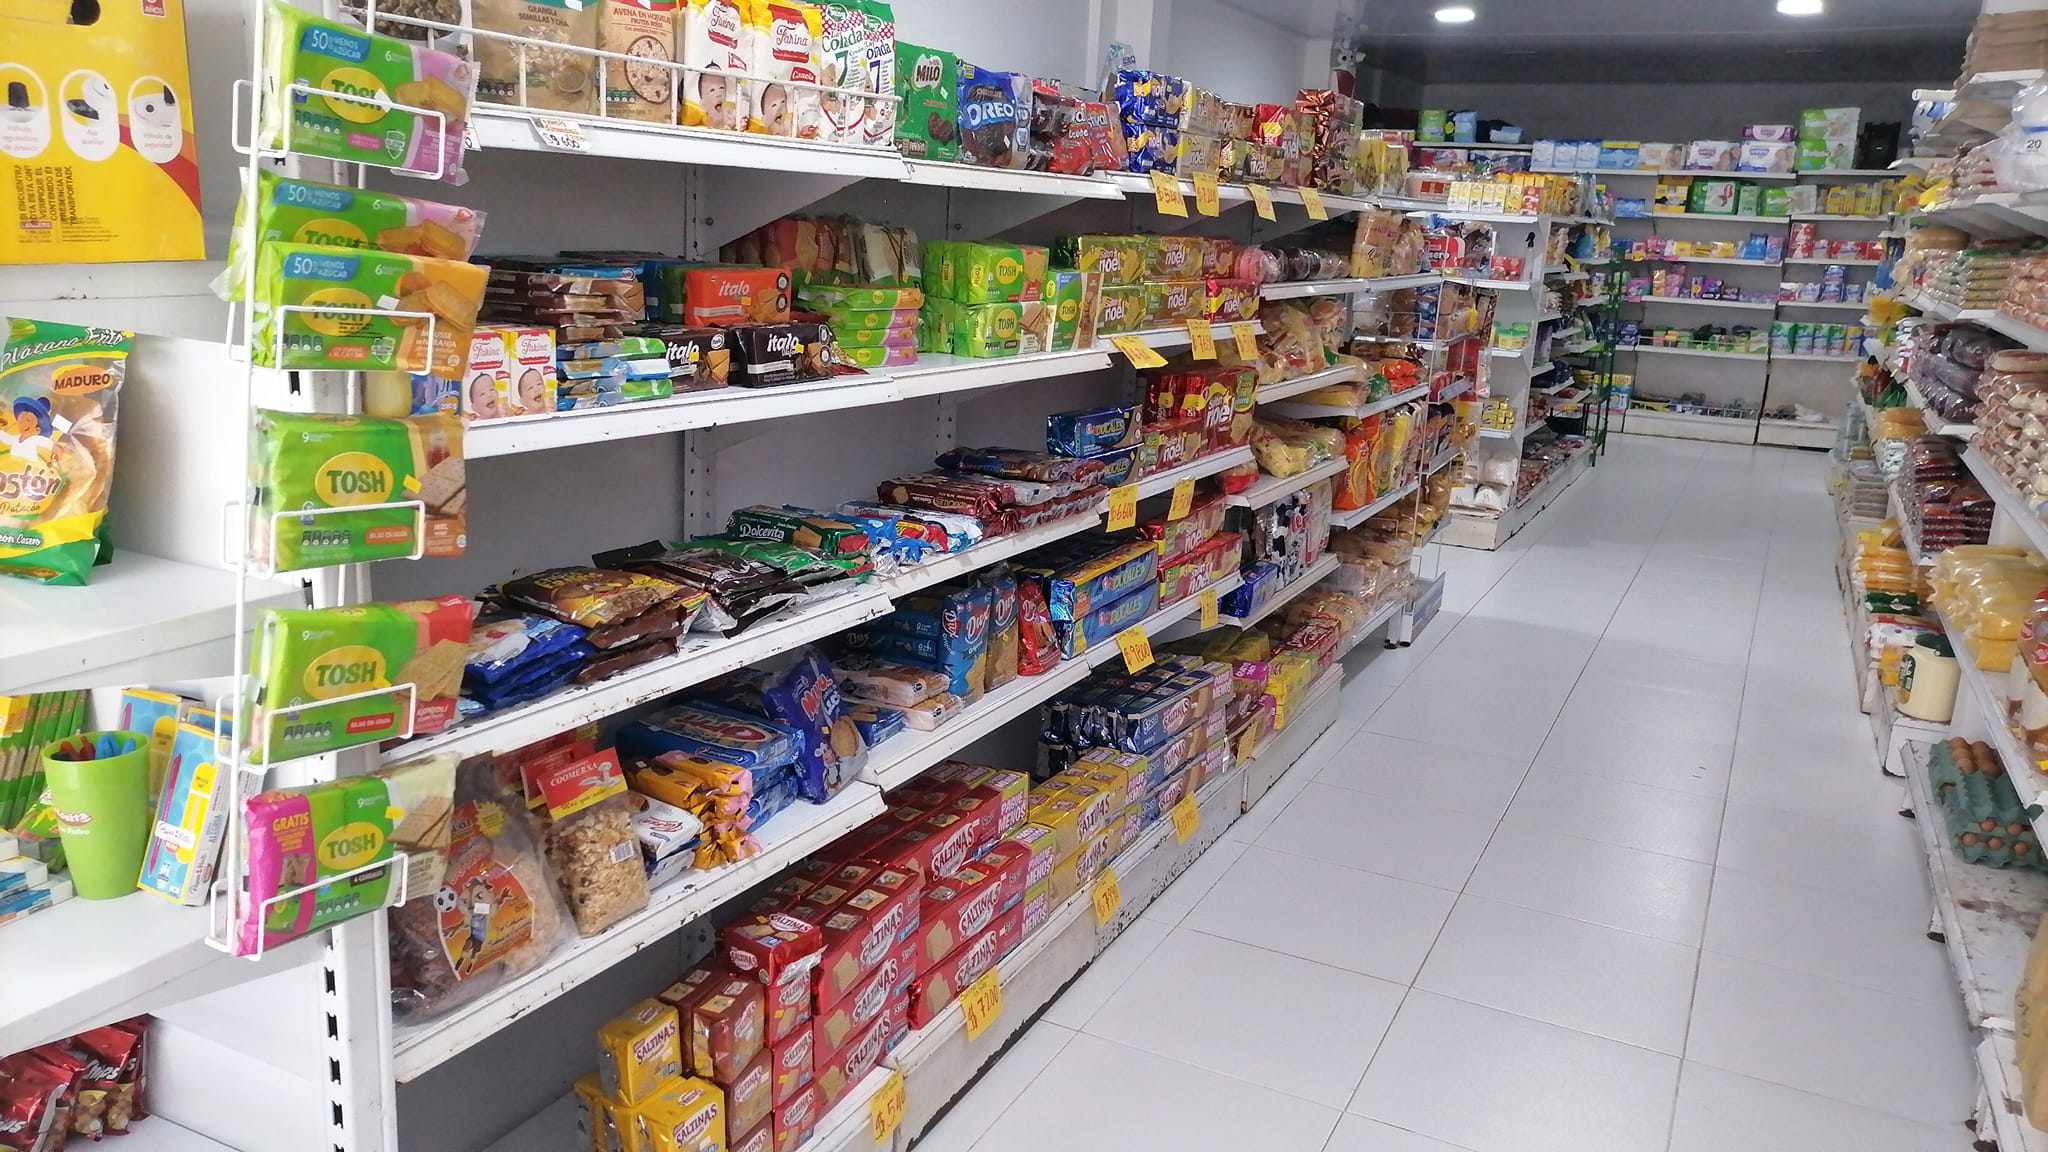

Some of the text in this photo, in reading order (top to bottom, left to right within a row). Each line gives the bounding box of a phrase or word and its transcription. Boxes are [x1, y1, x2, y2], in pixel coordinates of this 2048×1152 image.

[613, 7, 638, 18] AVENA
[310, 29, 329, 50] 50
[384, 50, 393, 62] 6
[835, 50, 849, 87] 7
[869, 60, 881, 95] 7
[916, 64, 941, 82] MILO
[967, 101, 1014, 126] OREO
[2026, 138, 2043, 150] 20
[287, 184, 306, 203] 50
[373, 199, 381, 210] 6
[293, 258, 313, 274] 50
[1099, 254, 1121, 273] noel
[1166, 249, 1186, 265] noel
[375, 264, 384, 275] 6
[998, 263, 1017, 278] TOSH
[719, 280, 751, 297] italo
[1061, 305, 1076, 316] TOSH
[1168, 293, 1188, 309] noel
[1105, 304, 1125, 322] noel
[997, 317, 1015, 331] TOSH
[666, 340, 700, 361] italo
[767, 332, 800, 353] italo
[54, 372, 111, 392] MADURO
[1206, 397, 1236, 428] noel
[302, 432, 310, 444] 9
[326, 470, 386, 494] TOSH
[739, 522, 785, 540] Dolcevita
[1188, 563, 1213, 595] noel
[995, 594, 1016, 625] Dux
[965, 605, 991, 643] Dux
[315, 661, 378, 688] TOSH
[550, 762, 599, 787] COOMERXA
[357, 797, 365, 809] 9
[1001, 790, 1024, 816] PAGUE
[271, 812, 310, 832] GRATIS
[998, 800, 1028, 834] MENOS
[326, 832, 376, 860] TOSH
[931, 823, 975, 881] SALTINAS
[1025, 854, 1055, 890] MENOS
[961, 881, 1002, 942] SALTINAS
[1023, 892, 1045, 921] PAGUE
[769, 912, 814, 934] SALTINAS
[1022, 902, 1047, 938] MENOS
[635, 1020, 677, 1066] SALTINAS
[784, 1031, 813, 1068] SALTINAS
[847, 1011, 892, 1079] SALTINAS
[785, 1088, 814, 1126] SALTINAS
[675, 1103, 718, 1149] SALTINAS
